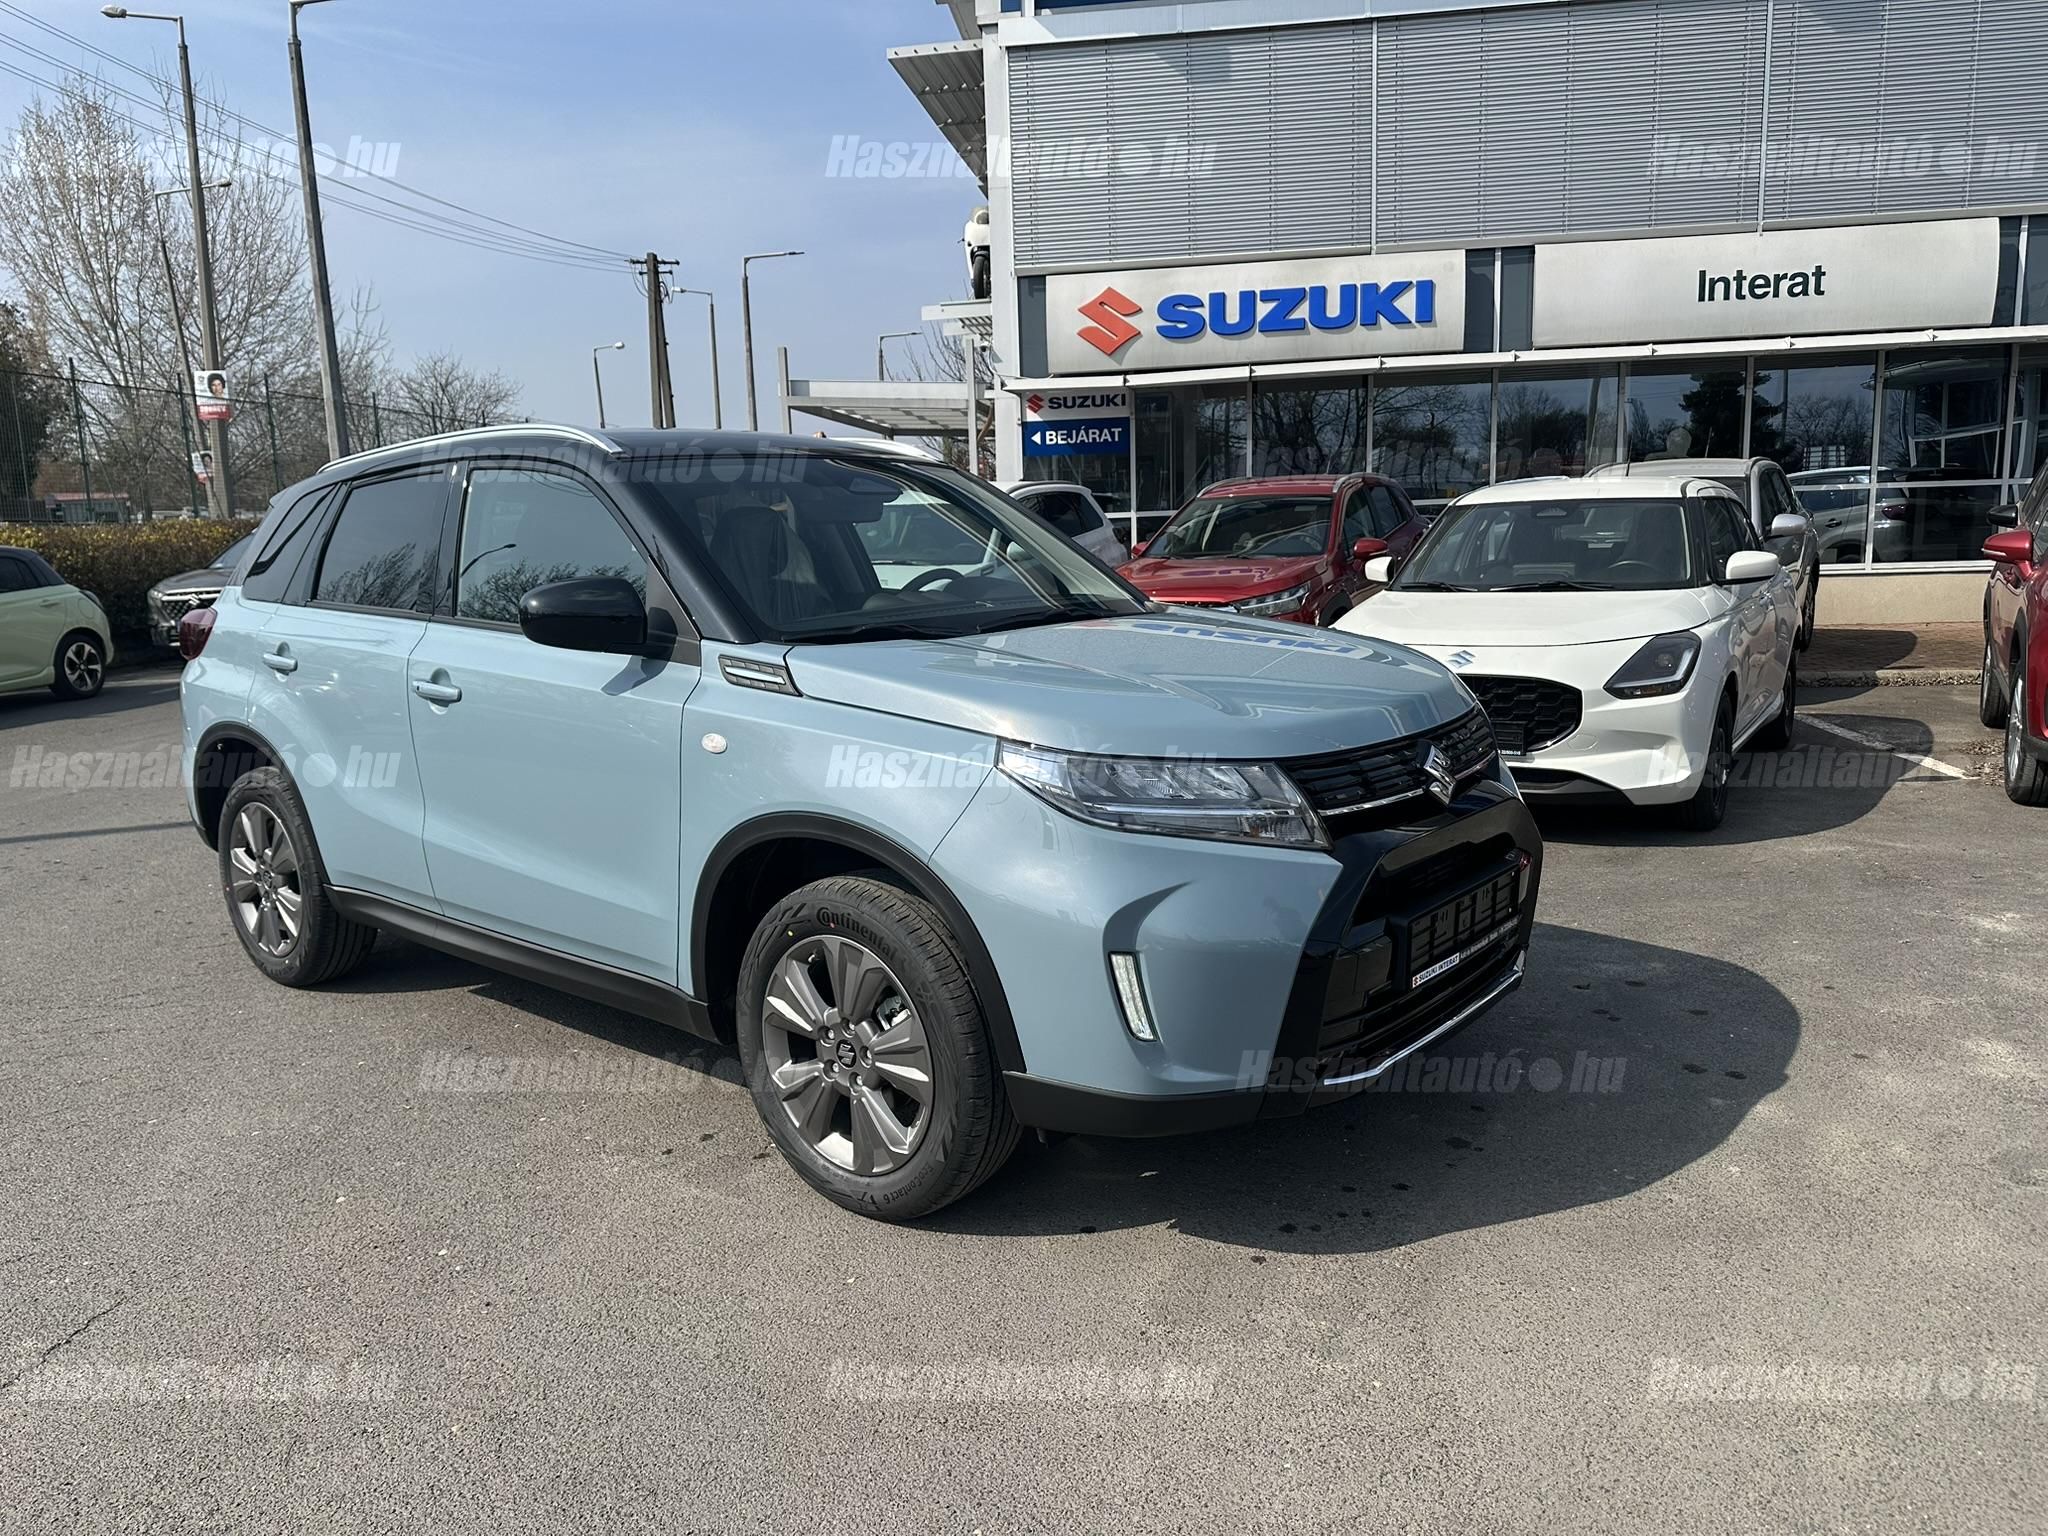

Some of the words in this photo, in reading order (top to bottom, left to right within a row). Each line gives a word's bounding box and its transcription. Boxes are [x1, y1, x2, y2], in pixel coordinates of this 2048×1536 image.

[1698, 264, 1826, 303] Interat
[1154, 279, 1436, 340] SUZUKI
[1047, 393, 1126, 410] SUZUKI
[1045, 425, 1123, 446] BEJÁRAT
[815, 906, 898, 962] Continental
[1418, 965, 1438, 983] SUZUKI
